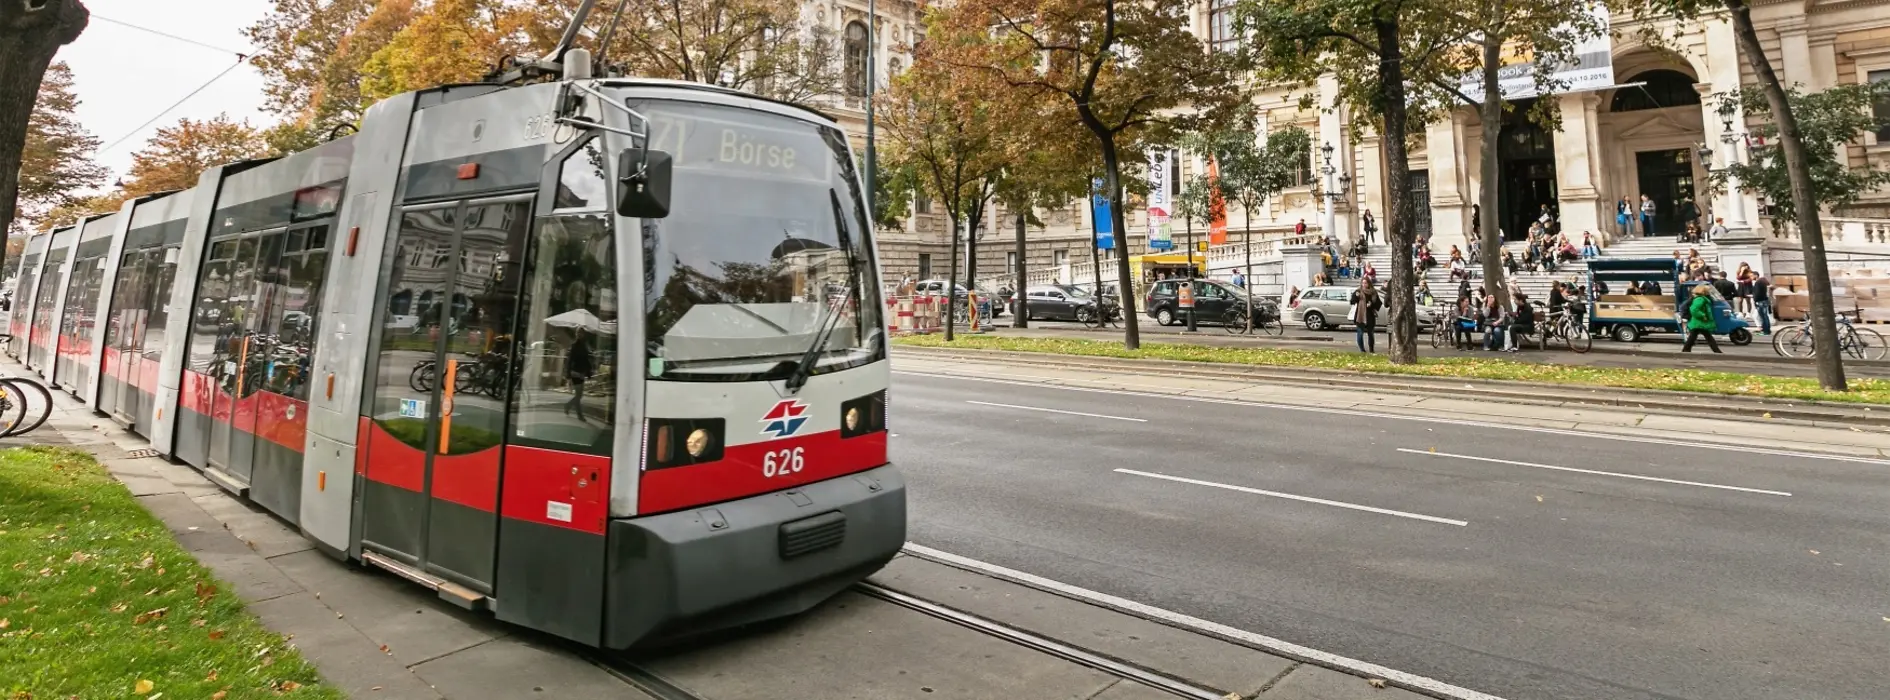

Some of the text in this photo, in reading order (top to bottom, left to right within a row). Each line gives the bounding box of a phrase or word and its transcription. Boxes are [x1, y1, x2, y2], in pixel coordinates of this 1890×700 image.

[524, 113, 550, 140] 626
[719, 128, 796, 169] Börse
[763, 446, 804, 478] 626
